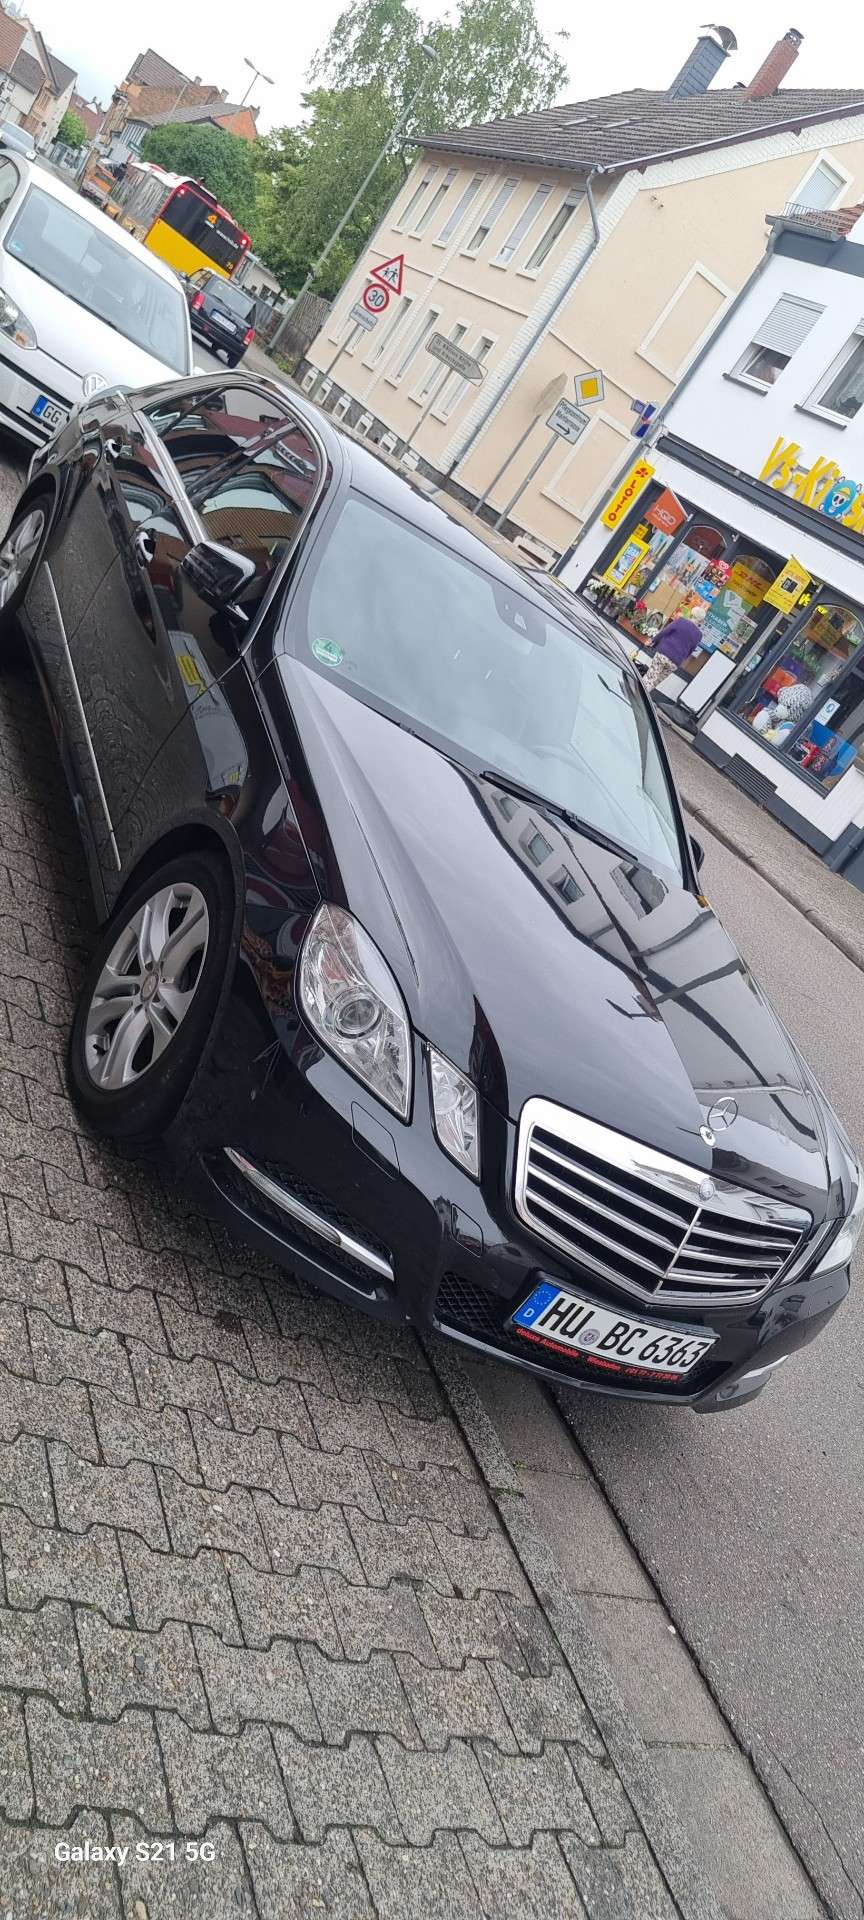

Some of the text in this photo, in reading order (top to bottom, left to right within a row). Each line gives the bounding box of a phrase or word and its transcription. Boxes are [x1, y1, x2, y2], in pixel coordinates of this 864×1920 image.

[368, 289, 385, 307] 30
[43, 405, 62, 424] GG
[608, 480, 637, 521] LOTTO
[523, 1308, 535, 1318] D
[538, 1297, 710, 1367] HU BC 6363
